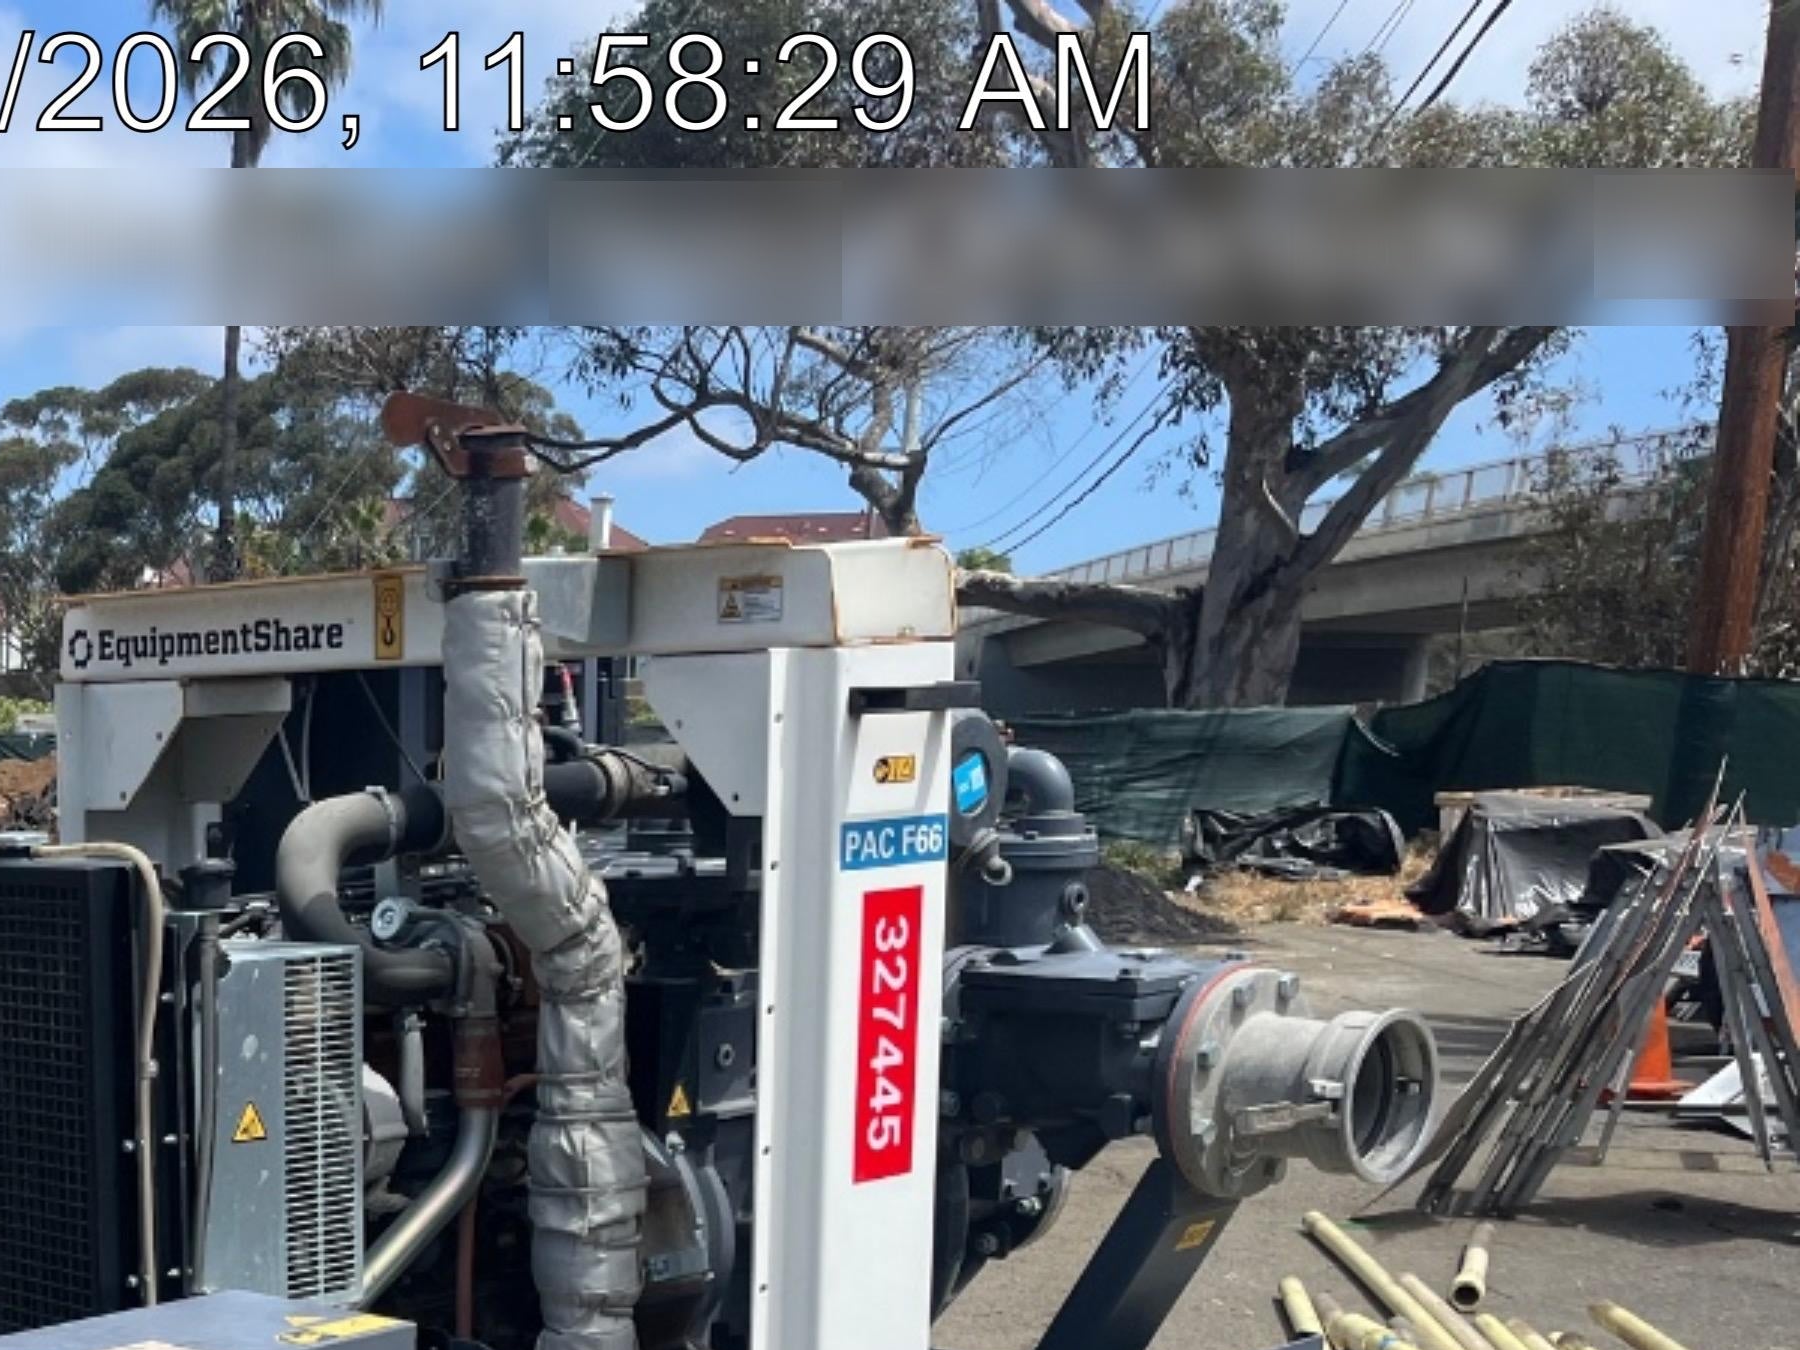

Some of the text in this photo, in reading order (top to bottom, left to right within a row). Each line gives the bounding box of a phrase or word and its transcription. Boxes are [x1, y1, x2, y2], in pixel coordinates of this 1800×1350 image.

[98, 618, 344, 667] EquipmentShare
[844, 823, 943, 863] PAC F66
[866, 914, 910, 1151] 327445
